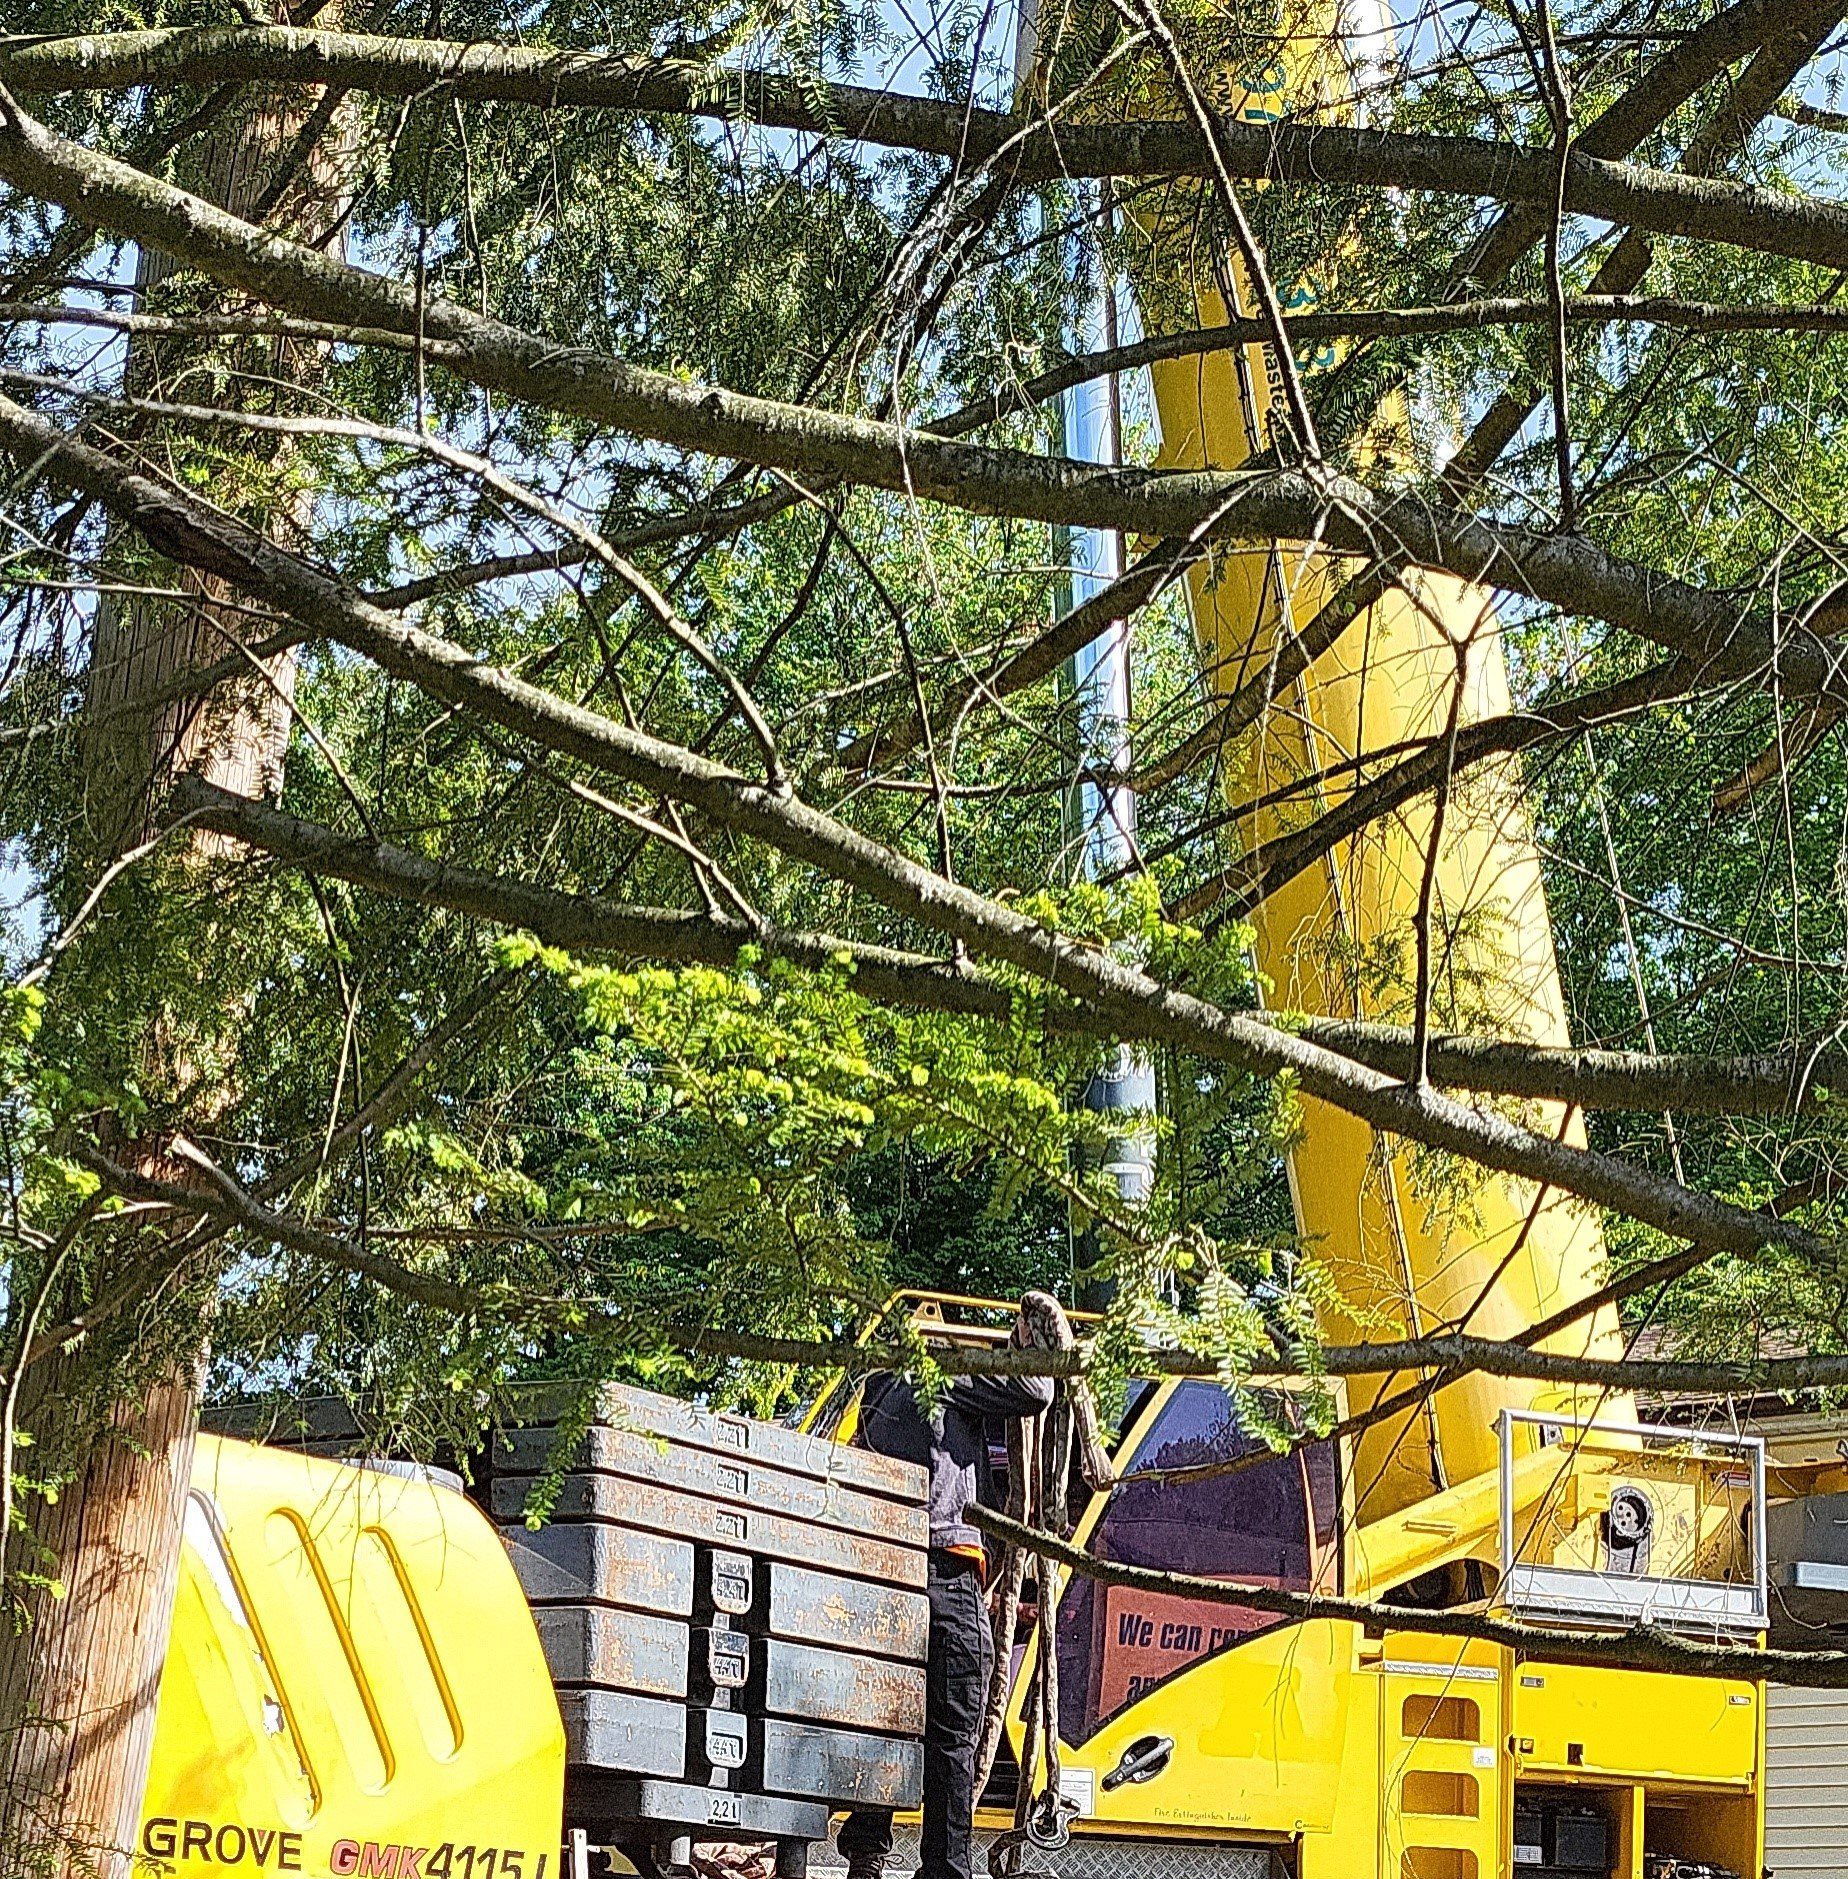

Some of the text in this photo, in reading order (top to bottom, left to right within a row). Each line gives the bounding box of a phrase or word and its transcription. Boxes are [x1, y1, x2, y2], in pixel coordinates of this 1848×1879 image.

[1118, 1613, 1153, 1648] We
[1160, 1622, 1202, 1652] can
[143, 1818, 302, 1871] GROVE
